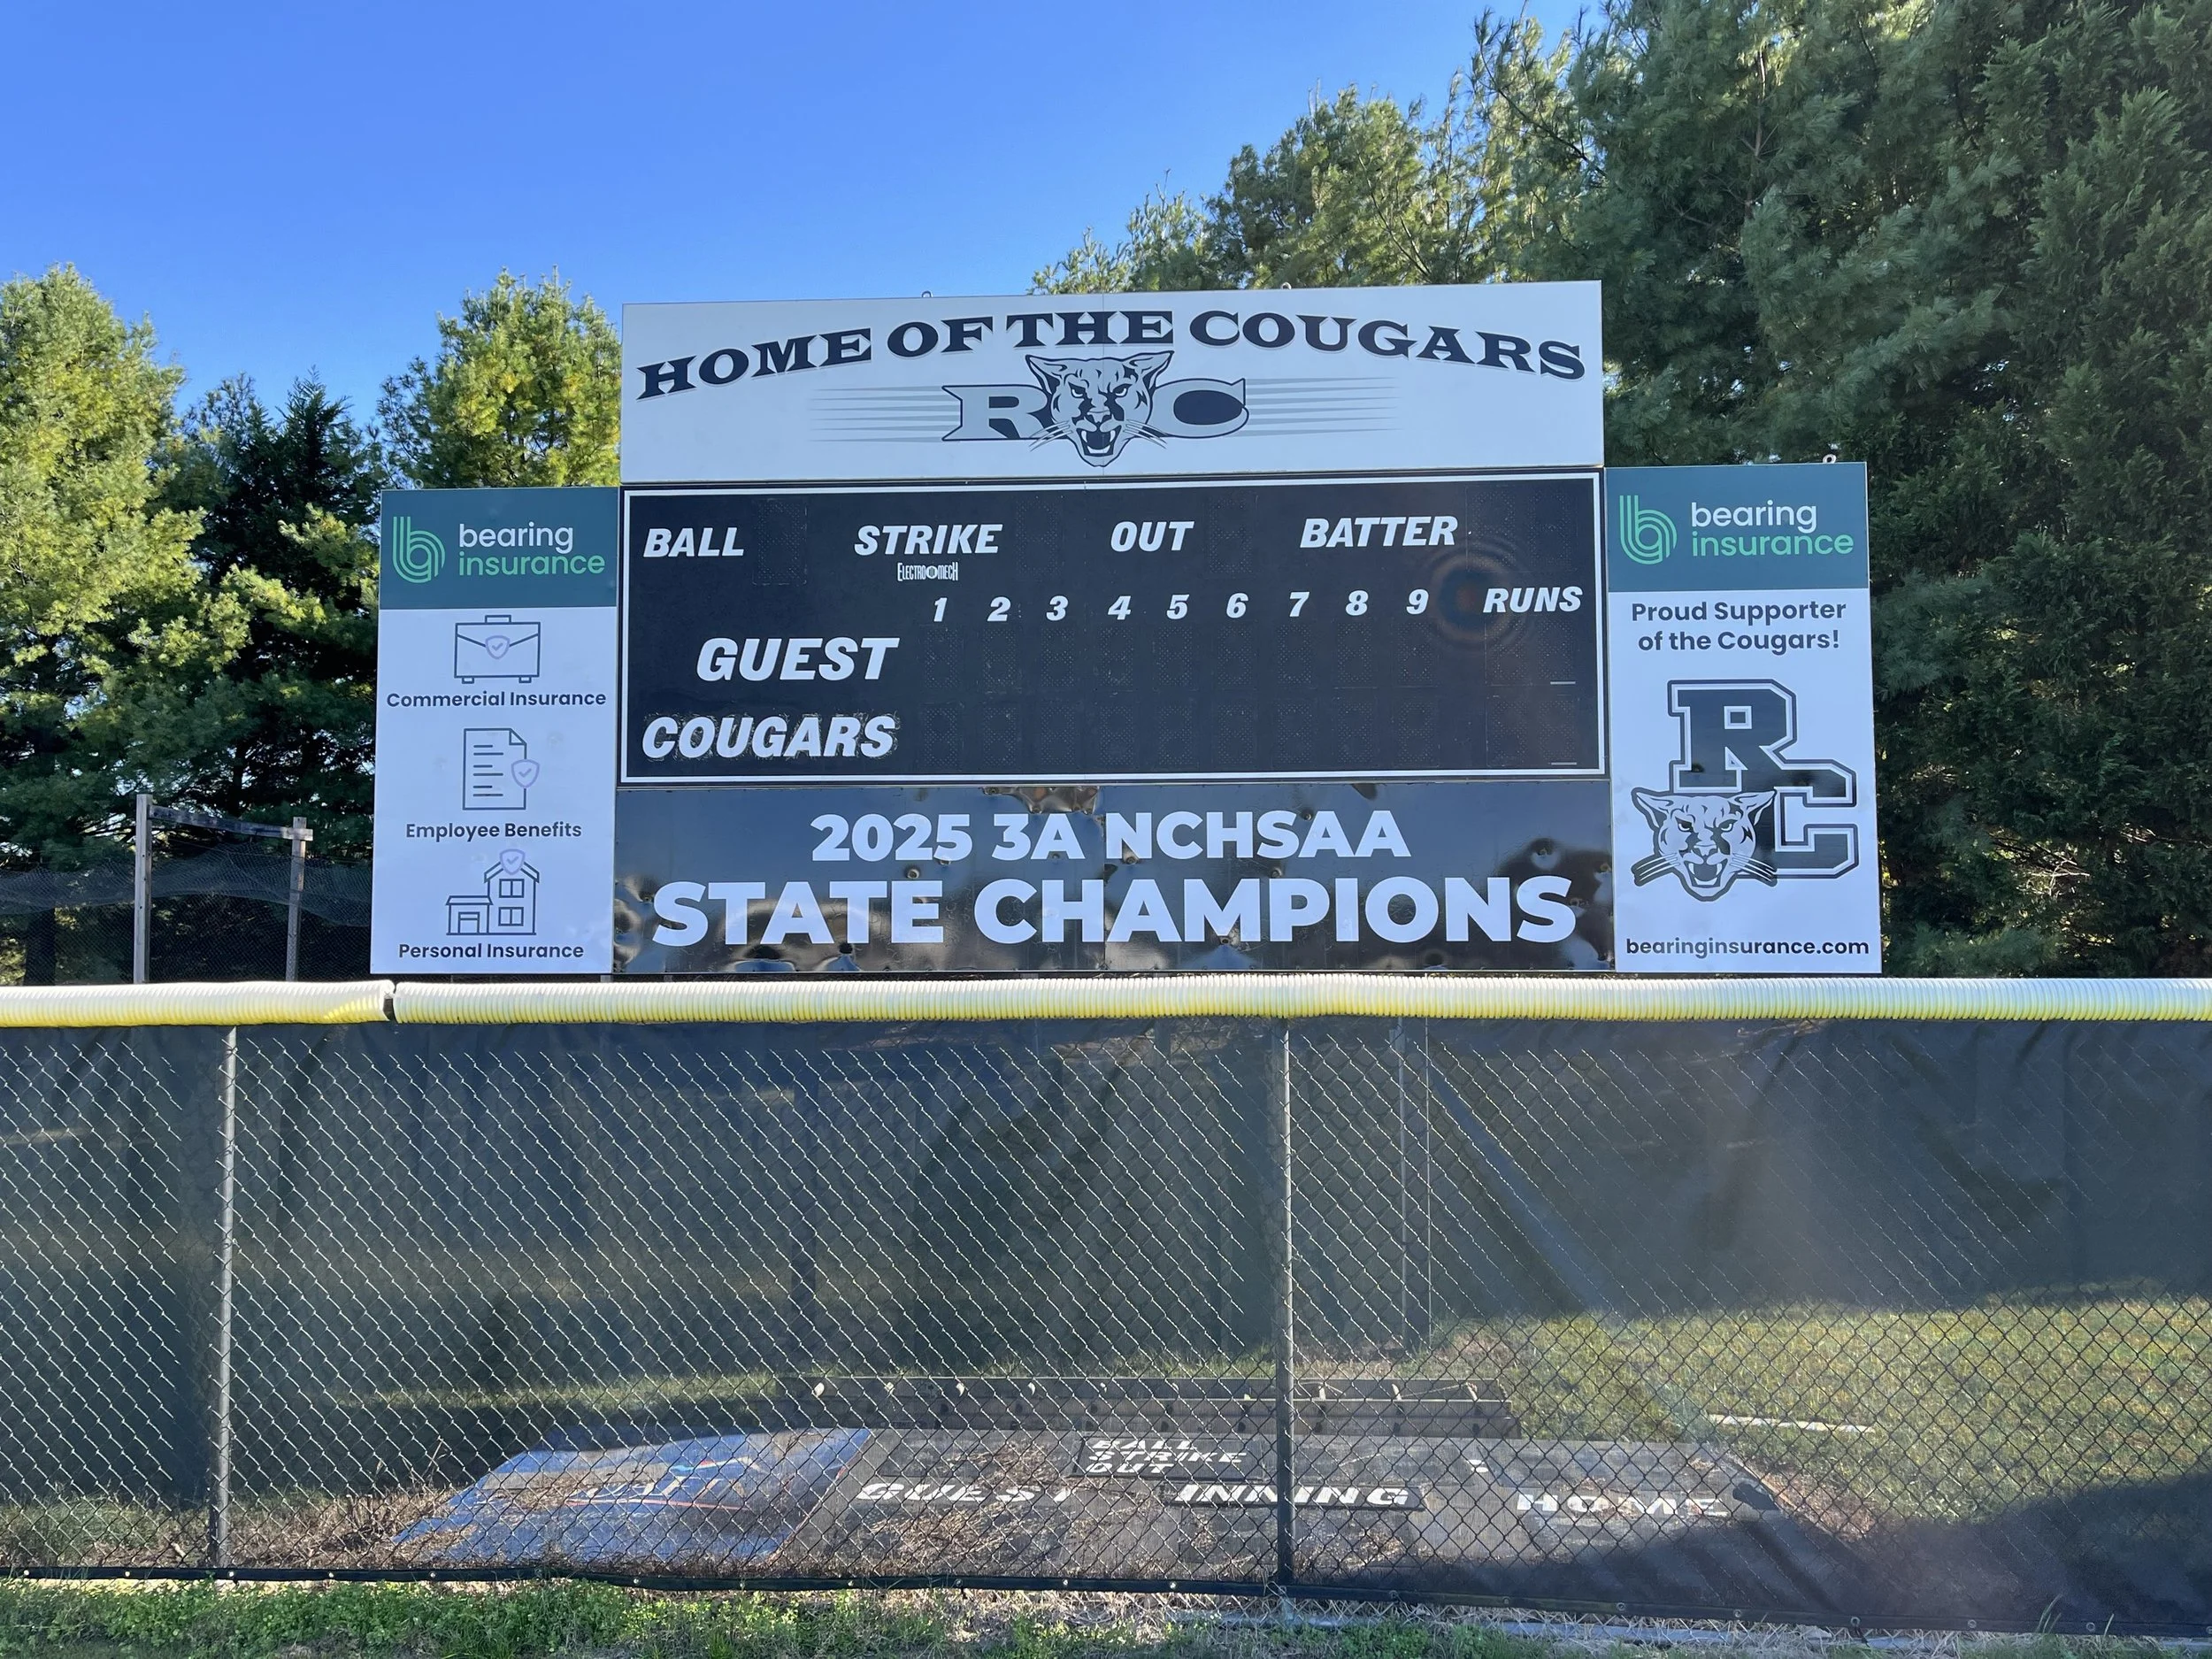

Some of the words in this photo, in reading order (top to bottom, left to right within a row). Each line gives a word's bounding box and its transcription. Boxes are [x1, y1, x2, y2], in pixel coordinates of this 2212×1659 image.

[636, 327, 872, 400] HOME
[887, 317, 993, 357] OF
[1006, 311, 1173, 347] THE
[1189, 311, 1585, 380] COUGARS
[1300, 515, 1458, 549] BATTER
[1691, 500, 1817, 534] bearing
[459, 521, 573, 554] bearing
[642, 527, 745, 558] BALL
[854, 524, 1003, 556] STRIKE
[1110, 521, 1194, 552] OUT
[1692, 531, 1855, 557] insurance
[459, 550, 605, 575] insurance
[933, 597, 948, 622] 1
[987, 596, 1011, 621] 2
[1046, 595, 1069, 620] 3
[1108, 595, 1132, 620] 4
[1166, 594, 1189, 619] 5
[1226, 592, 1248, 618] 6
[1289, 592, 1310, 617] 7
[1345, 590, 1368, 616] 8
[1406, 588, 1429, 615] 9
[1483, 586, 1583, 614] RUNS
[1632, 602, 1707, 621] Proud
[1714, 601, 1847, 626] Supporter
[1638, 631, 1663, 650] of
[1669, 632, 1711, 650] the
[1717, 629, 1839, 656] Cougars!
[696, 637, 900, 681] GUEST
[386, 691, 505, 707] Commercial
[510, 691, 606, 706] Insurance
[641, 715, 899, 758] COUGARS
[406, 823, 500, 842] Employee
[505, 821, 582, 837] Benefits
[810, 814, 972, 861] 2025
[991, 813, 1085, 860] 3A
[1106, 810, 1411, 859] NCHSAA
[652, 879, 944, 947] STATE
[974, 875, 1576, 944] CHAMPIONS
[398, 943, 482, 958] Personal
[488, 944, 584, 958] Insurance
[1626, 938, 1869, 958] bearinginsurance.com
[1088, 1451, 1247, 1462] STRIKE
[1174, 1485, 1409, 1504] INNING
[1517, 1494, 1728, 1517] HOME
